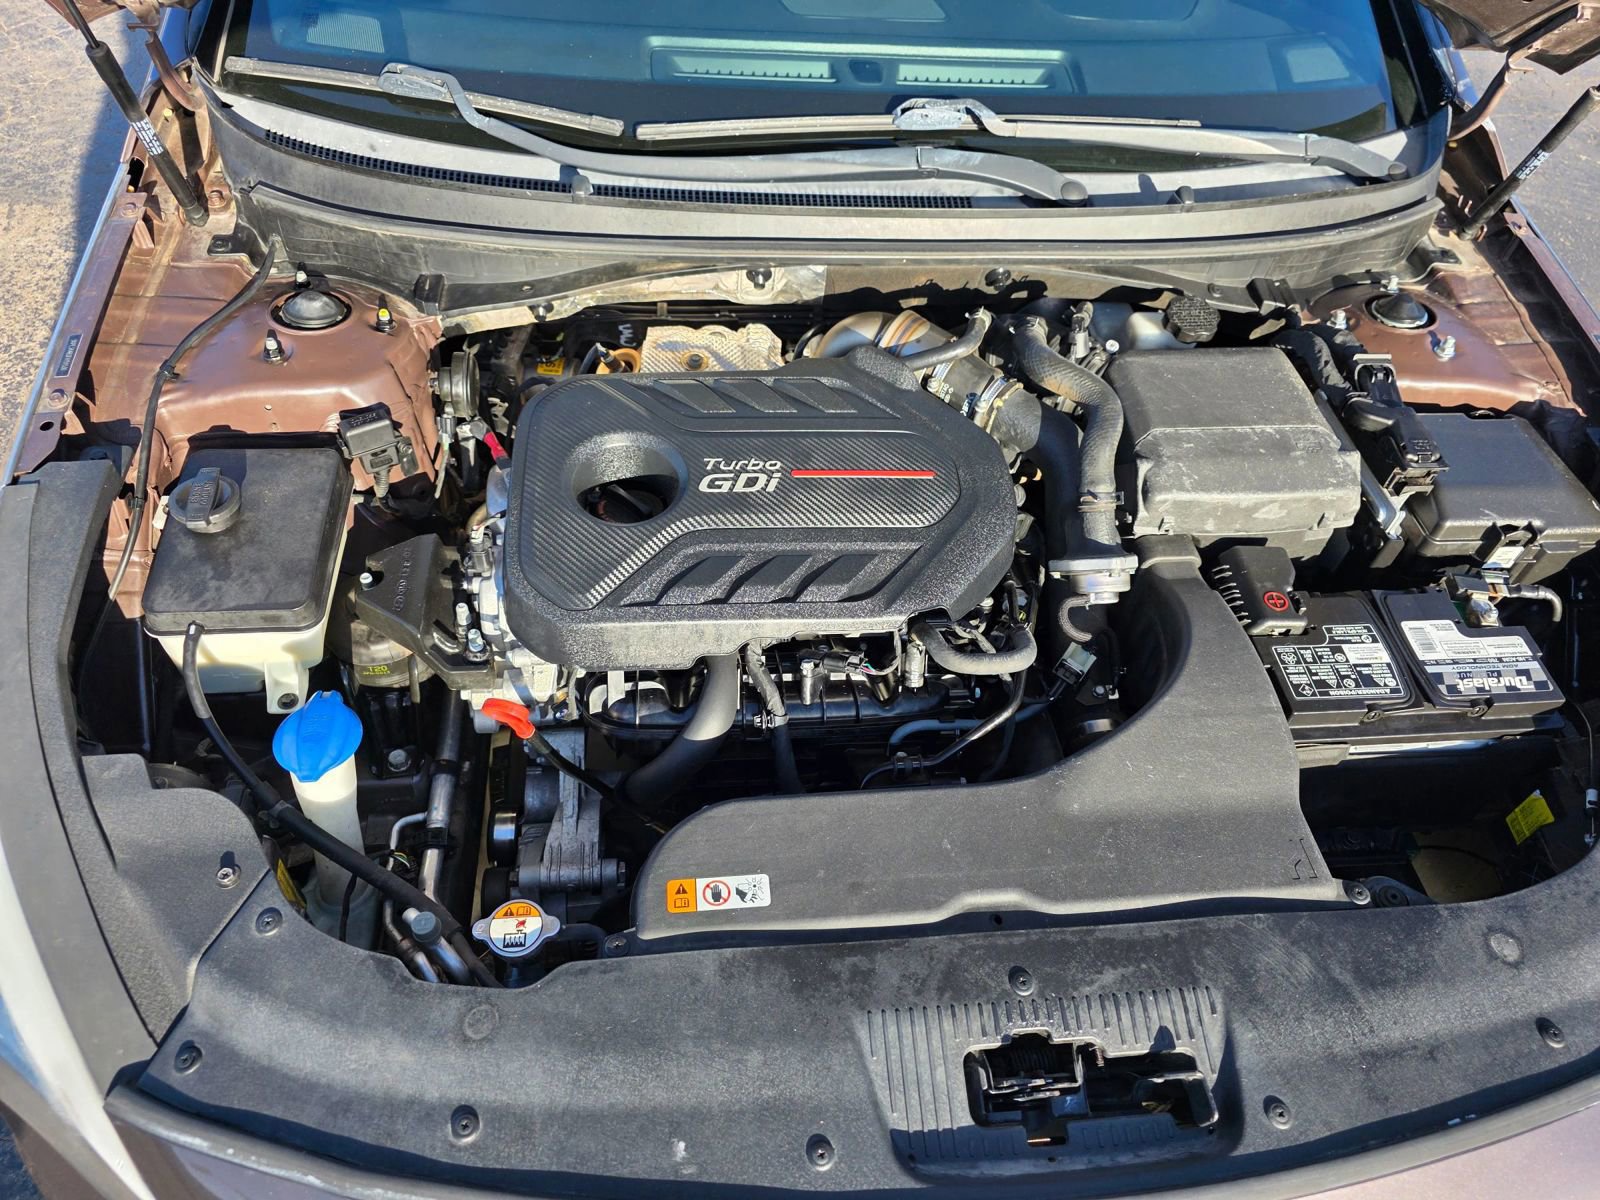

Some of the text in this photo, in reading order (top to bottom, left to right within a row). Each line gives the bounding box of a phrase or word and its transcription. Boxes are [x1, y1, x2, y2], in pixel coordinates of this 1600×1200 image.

[703, 457, 781, 470] Turbo
[698, 472, 782, 493] GDi
[1455, 675, 1535, 691] Duralast
